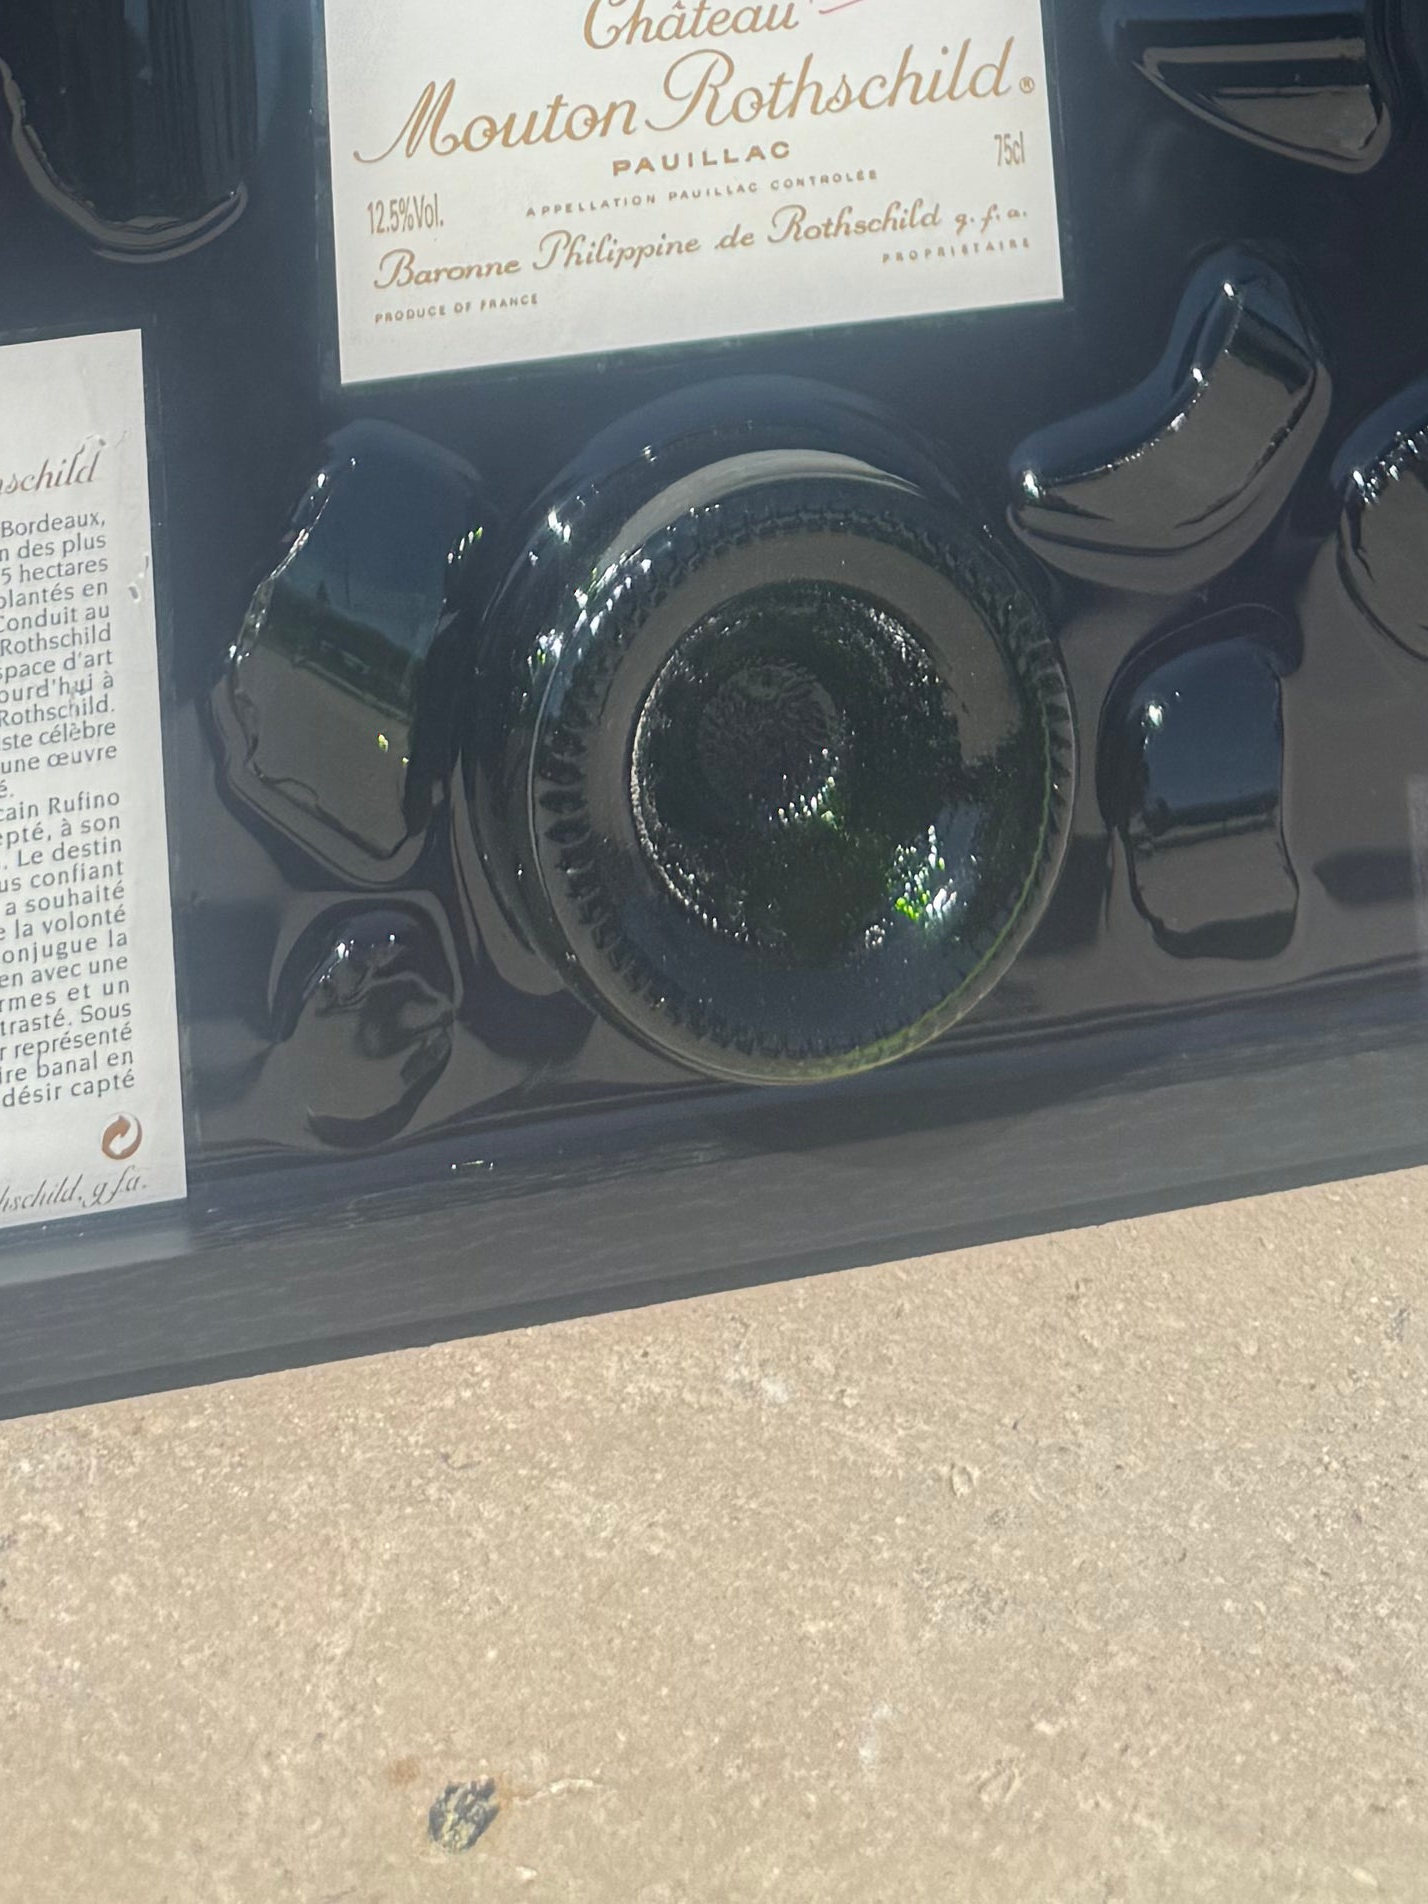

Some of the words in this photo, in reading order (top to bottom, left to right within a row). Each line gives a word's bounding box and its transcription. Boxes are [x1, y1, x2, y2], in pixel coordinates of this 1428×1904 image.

[352, 79, 637, 165] Mouton
[644, 35, 1015, 132] Rothschild
[611, 140, 790, 177] PAUILLAC
[993, 130, 1026, 167] 75cl
[525, 194, 656, 217] APPELLATION
[667, 181, 758, 202] PAUILLAC
[372, 247, 521, 290] Baronne
[531, 228, 701, 271] Philippine
[713, 223, 755, 250] de
[766, 197, 941, 244] Rothschild
[374, 304, 446, 324] PRODUCE
[479, 292, 538, 312] FRANCE
[0, 511, 106, 541] Bordeaux,
[16, 541, 55, 560] des
[62, 534, 107, 558] plus
[19, 557, 109, 583] hectares
[84, 605, 110, 621] au
[0, 624, 111, 657] Rothschild
[62, 649, 113, 671] d'art
[60, 823, 72, 838] à
[80, 816, 120, 835] son
[14, 921, 33, 940] la
[41, 905, 126, 935] volonté
[30, 964, 81, 984] avec
[88, 957, 128, 975] une
[66, 983, 91, 1002] et
[102, 981, 130, 996] un
[79, 1002, 132, 1024] Sous
[14, 1024, 132, 1061] représenté
[36, 1052, 98, 1079] banal
[106, 1052, 134, 1067] en
[1, 1084, 59, 1108] désir
[70, 1071, 135, 1098] capté
